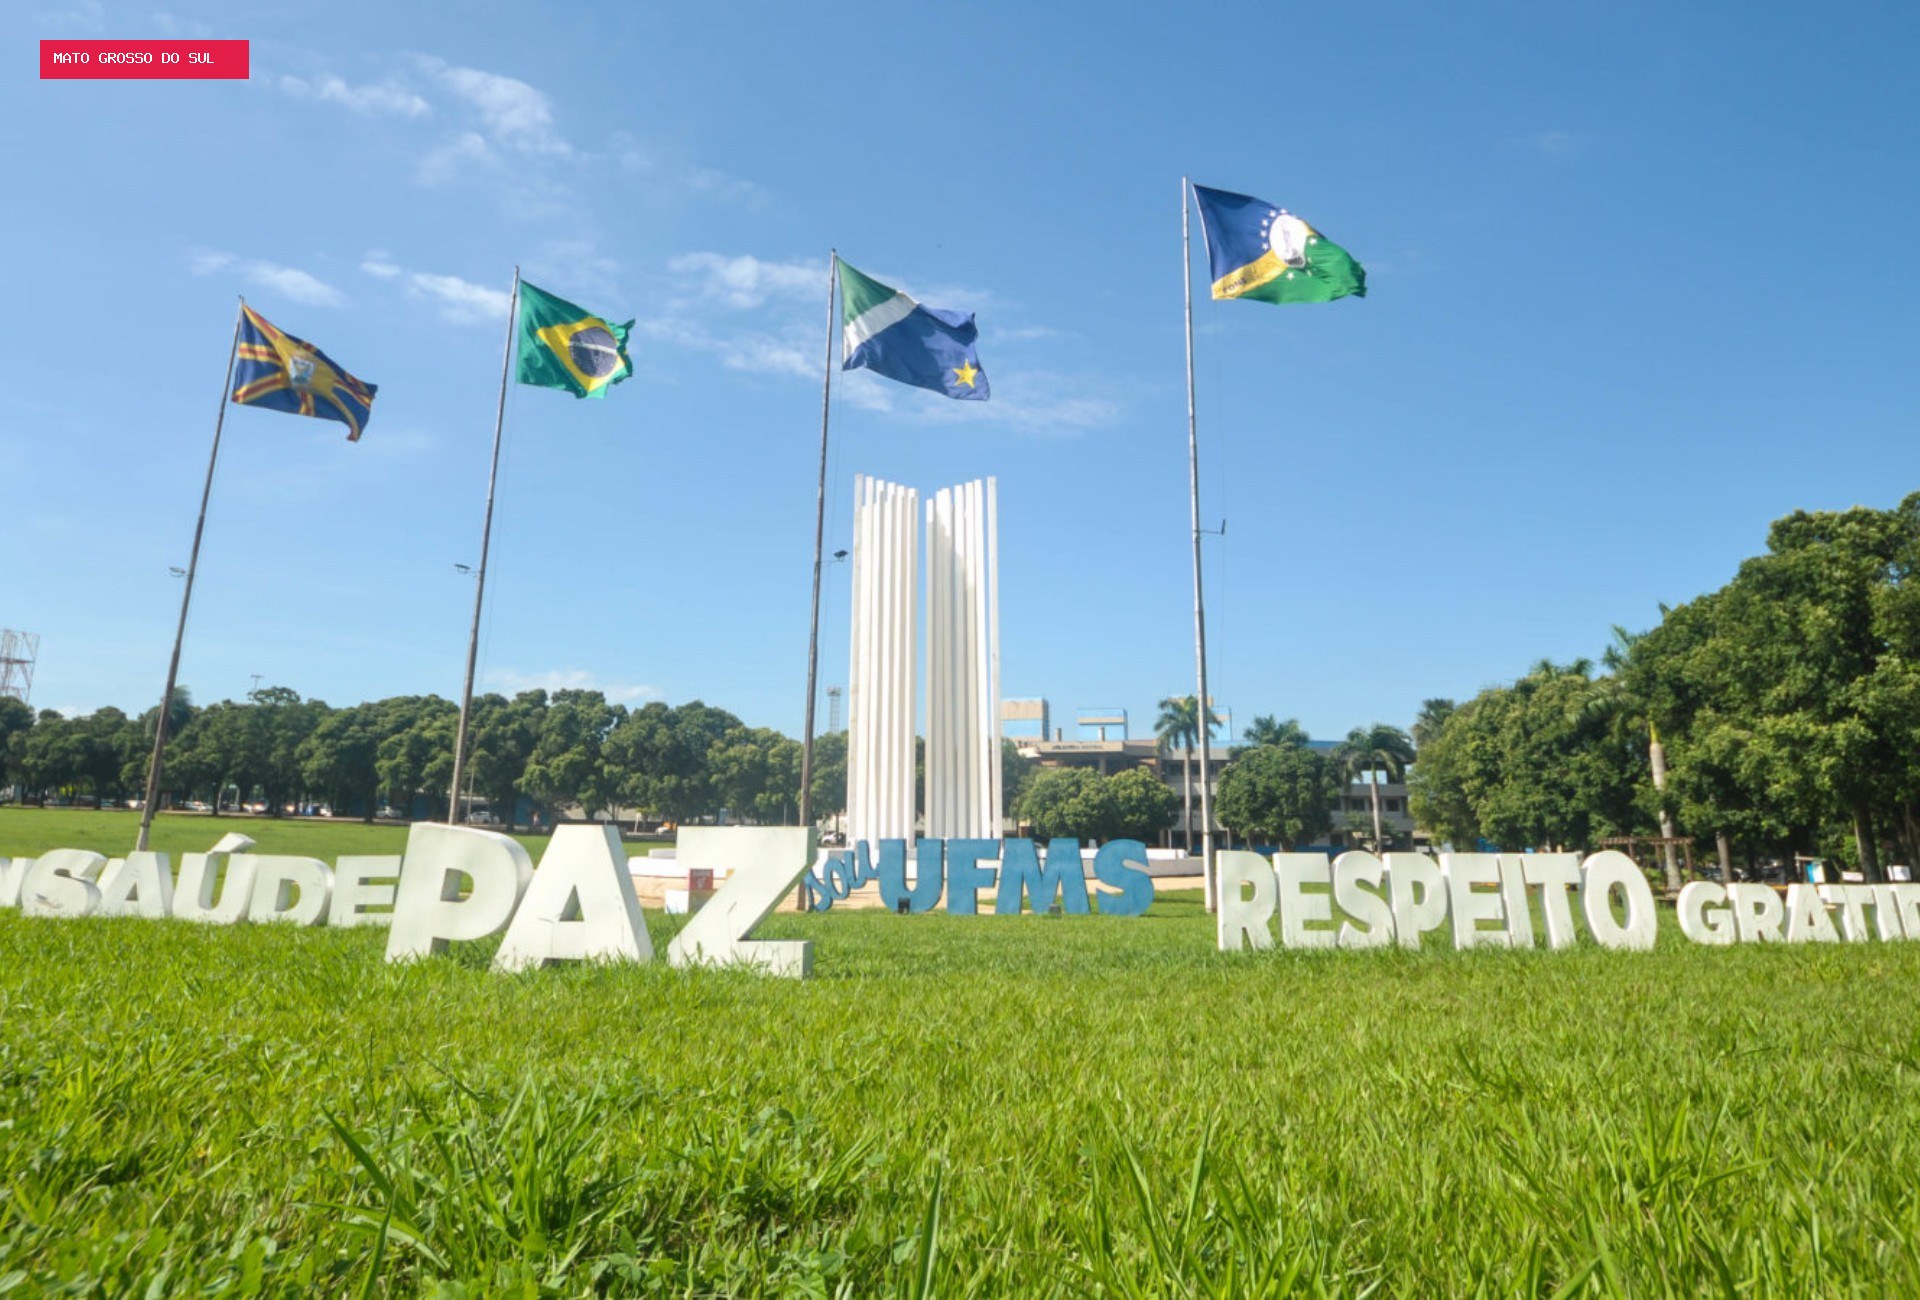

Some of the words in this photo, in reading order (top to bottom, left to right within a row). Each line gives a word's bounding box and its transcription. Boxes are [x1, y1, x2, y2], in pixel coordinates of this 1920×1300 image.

[20, 832, 401, 928] SAÚDE
[385, 821, 816, 979] PAZ
[878, 837, 1155, 917] UFMS
[1215, 850, 1657, 951] RESPEITO
